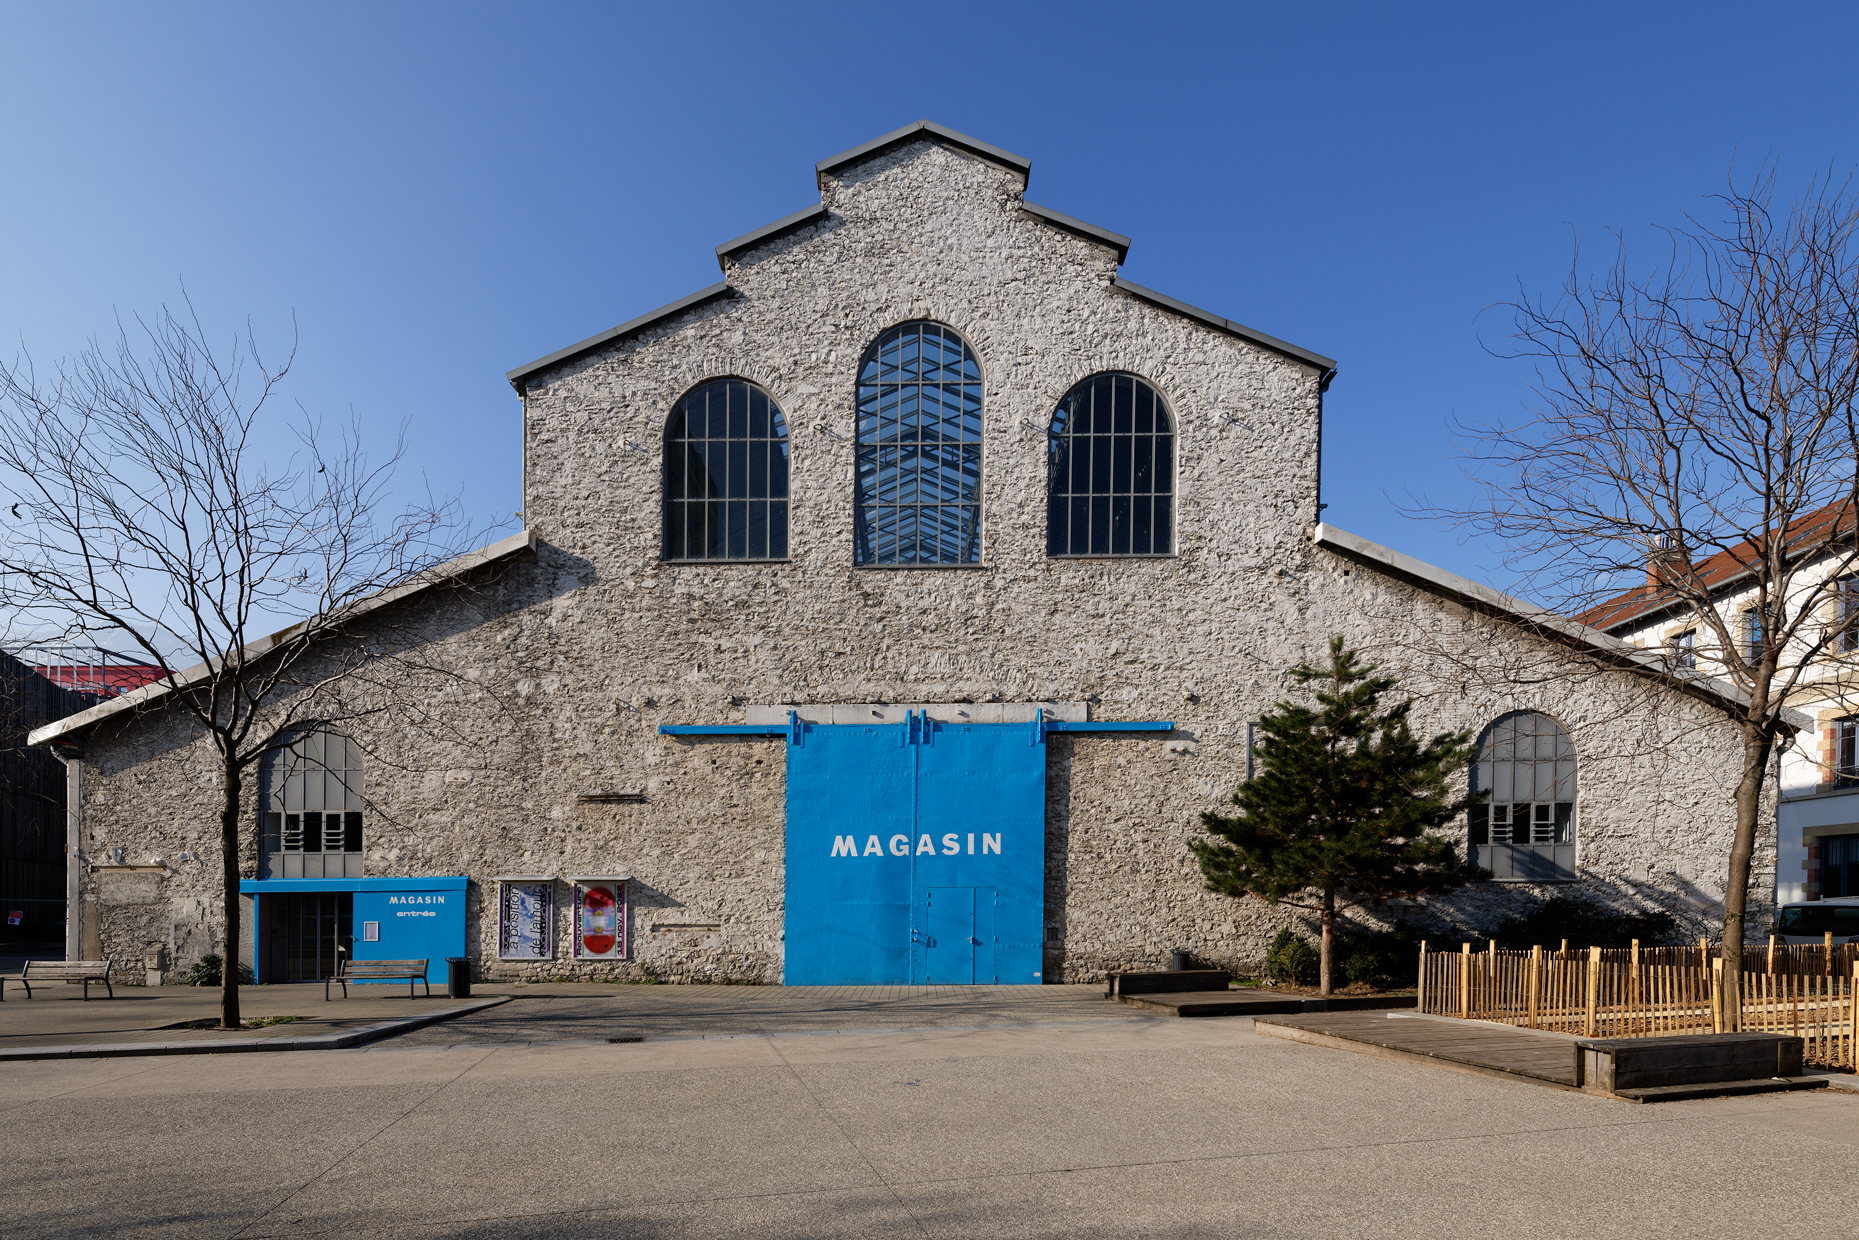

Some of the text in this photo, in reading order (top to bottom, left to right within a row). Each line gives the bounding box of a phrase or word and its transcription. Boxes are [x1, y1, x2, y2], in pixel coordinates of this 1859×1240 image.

[830, 833, 1002, 857] MAGASIN
[389, 896, 445, 904] MAGASIN
[509, 887, 521, 938] position
[529, 938, 542, 955] de
[617, 941, 623, 956] 18
